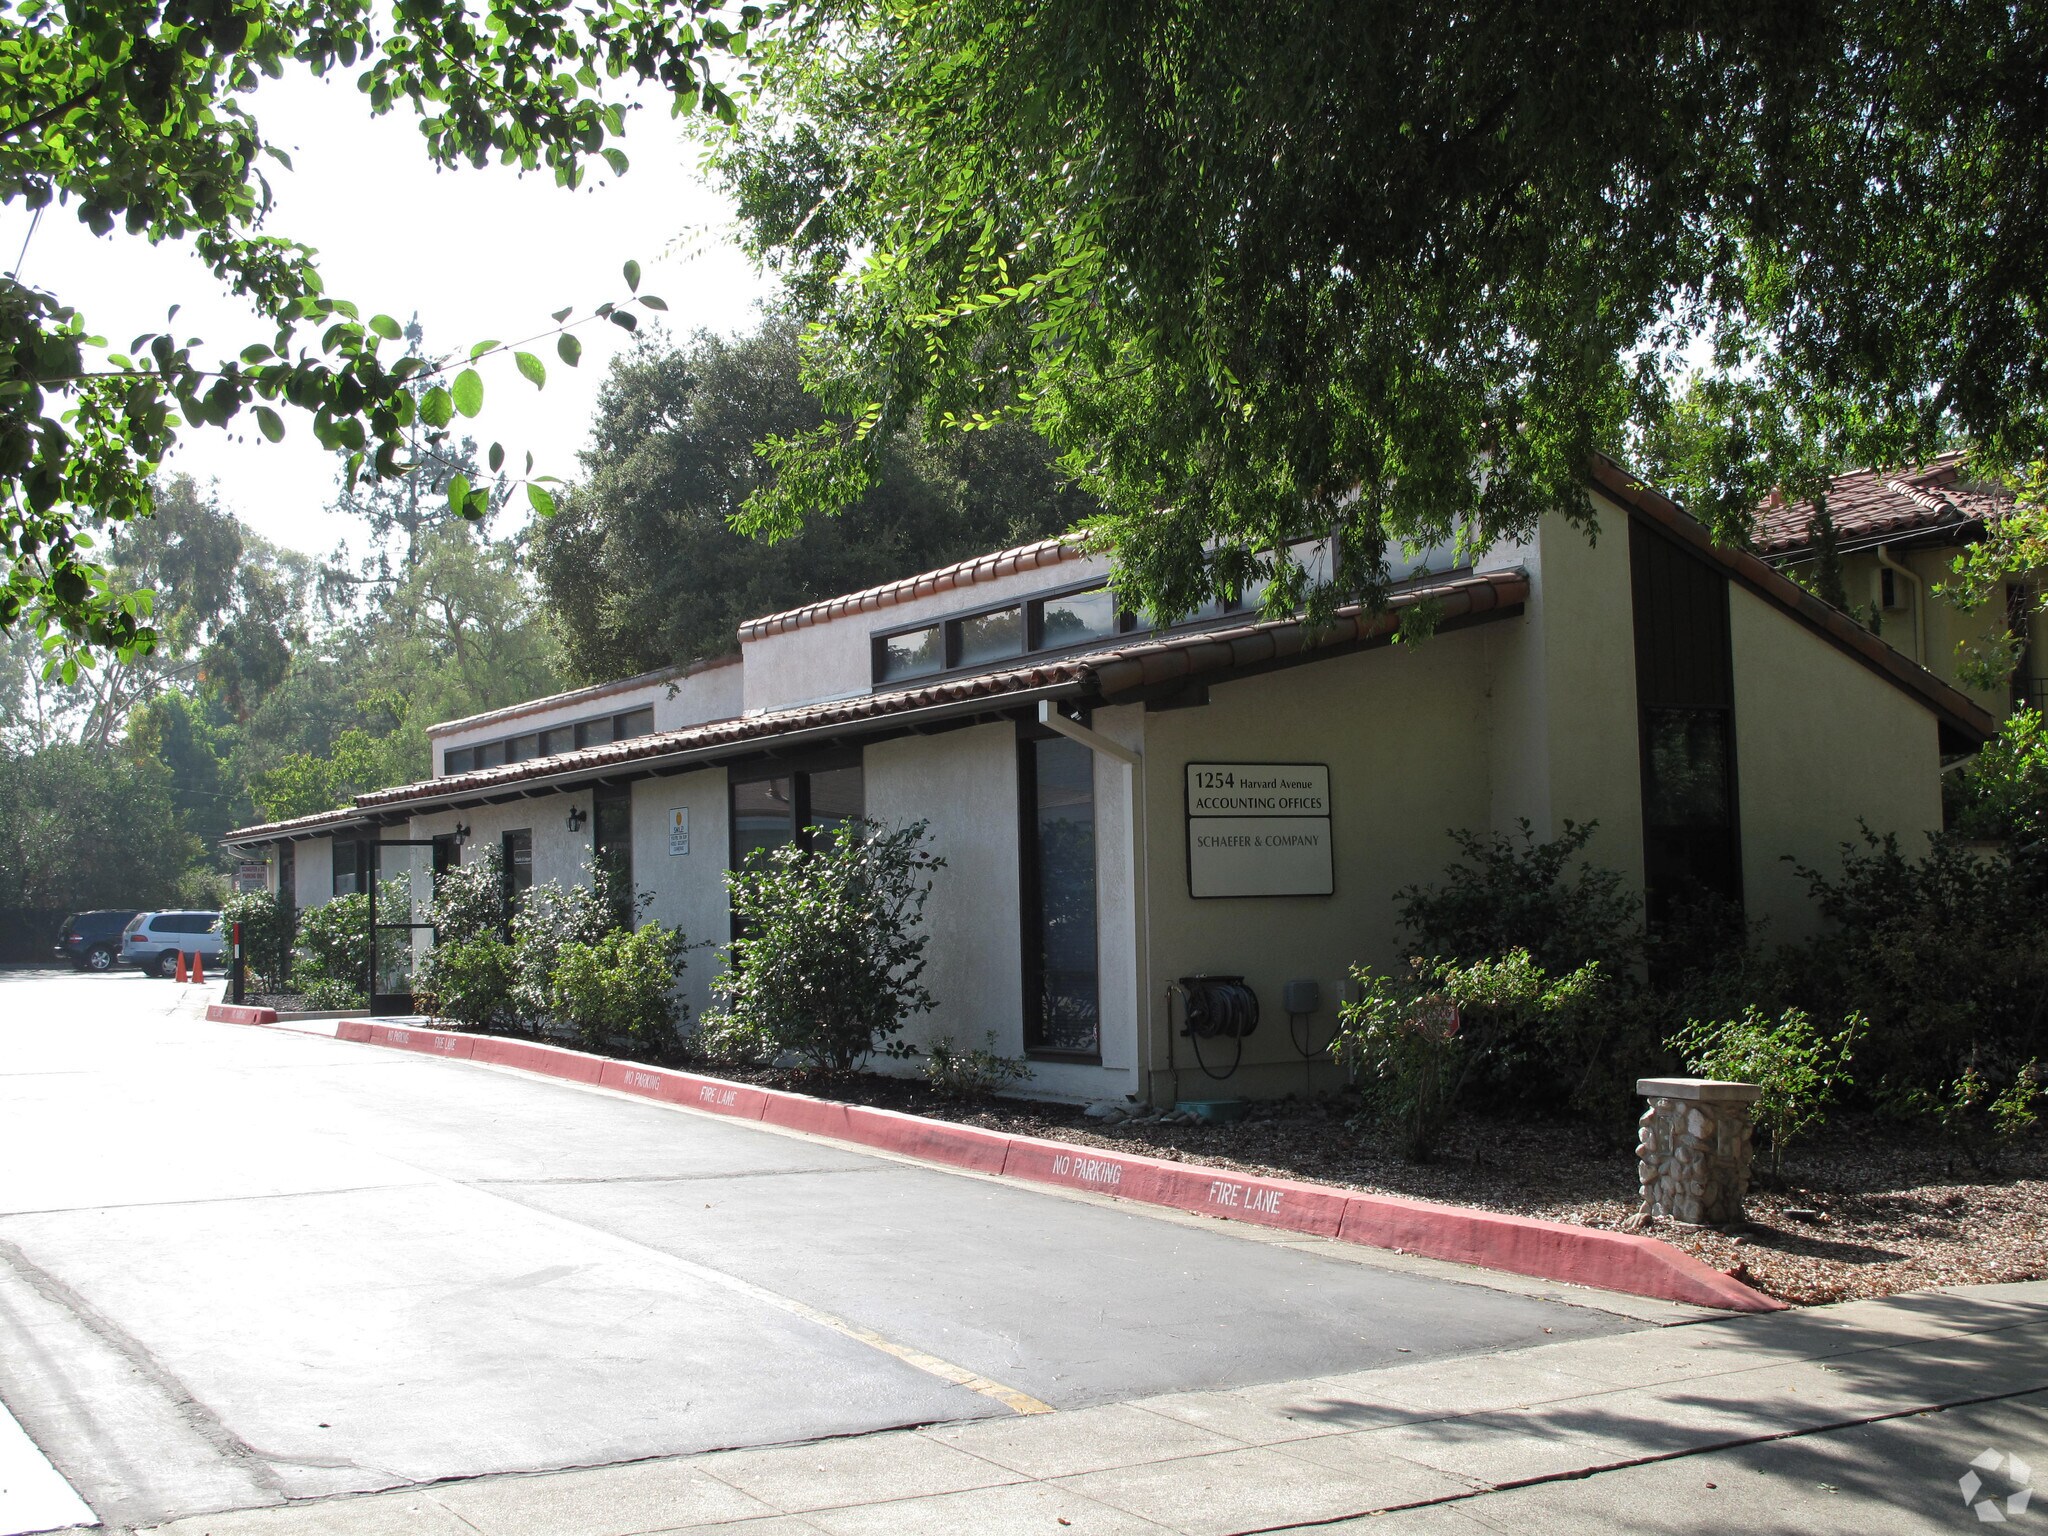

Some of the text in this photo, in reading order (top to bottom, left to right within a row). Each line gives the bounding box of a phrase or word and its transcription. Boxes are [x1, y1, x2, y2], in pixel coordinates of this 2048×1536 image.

[1195, 772, 1313, 789] 1254 Harvard Avenue
[1196, 797, 1322, 809] ACCOUNTING OFFICES
[1197, 835, 1320, 848] SCHAEFER & COMPANY
[624, 1070, 661, 1091] NO PARKING
[700, 1086, 737, 1107] FIRE LANE
[1052, 1154, 1122, 1184] NO PARKING
[1208, 1181, 1284, 1214] FIRE LANE
